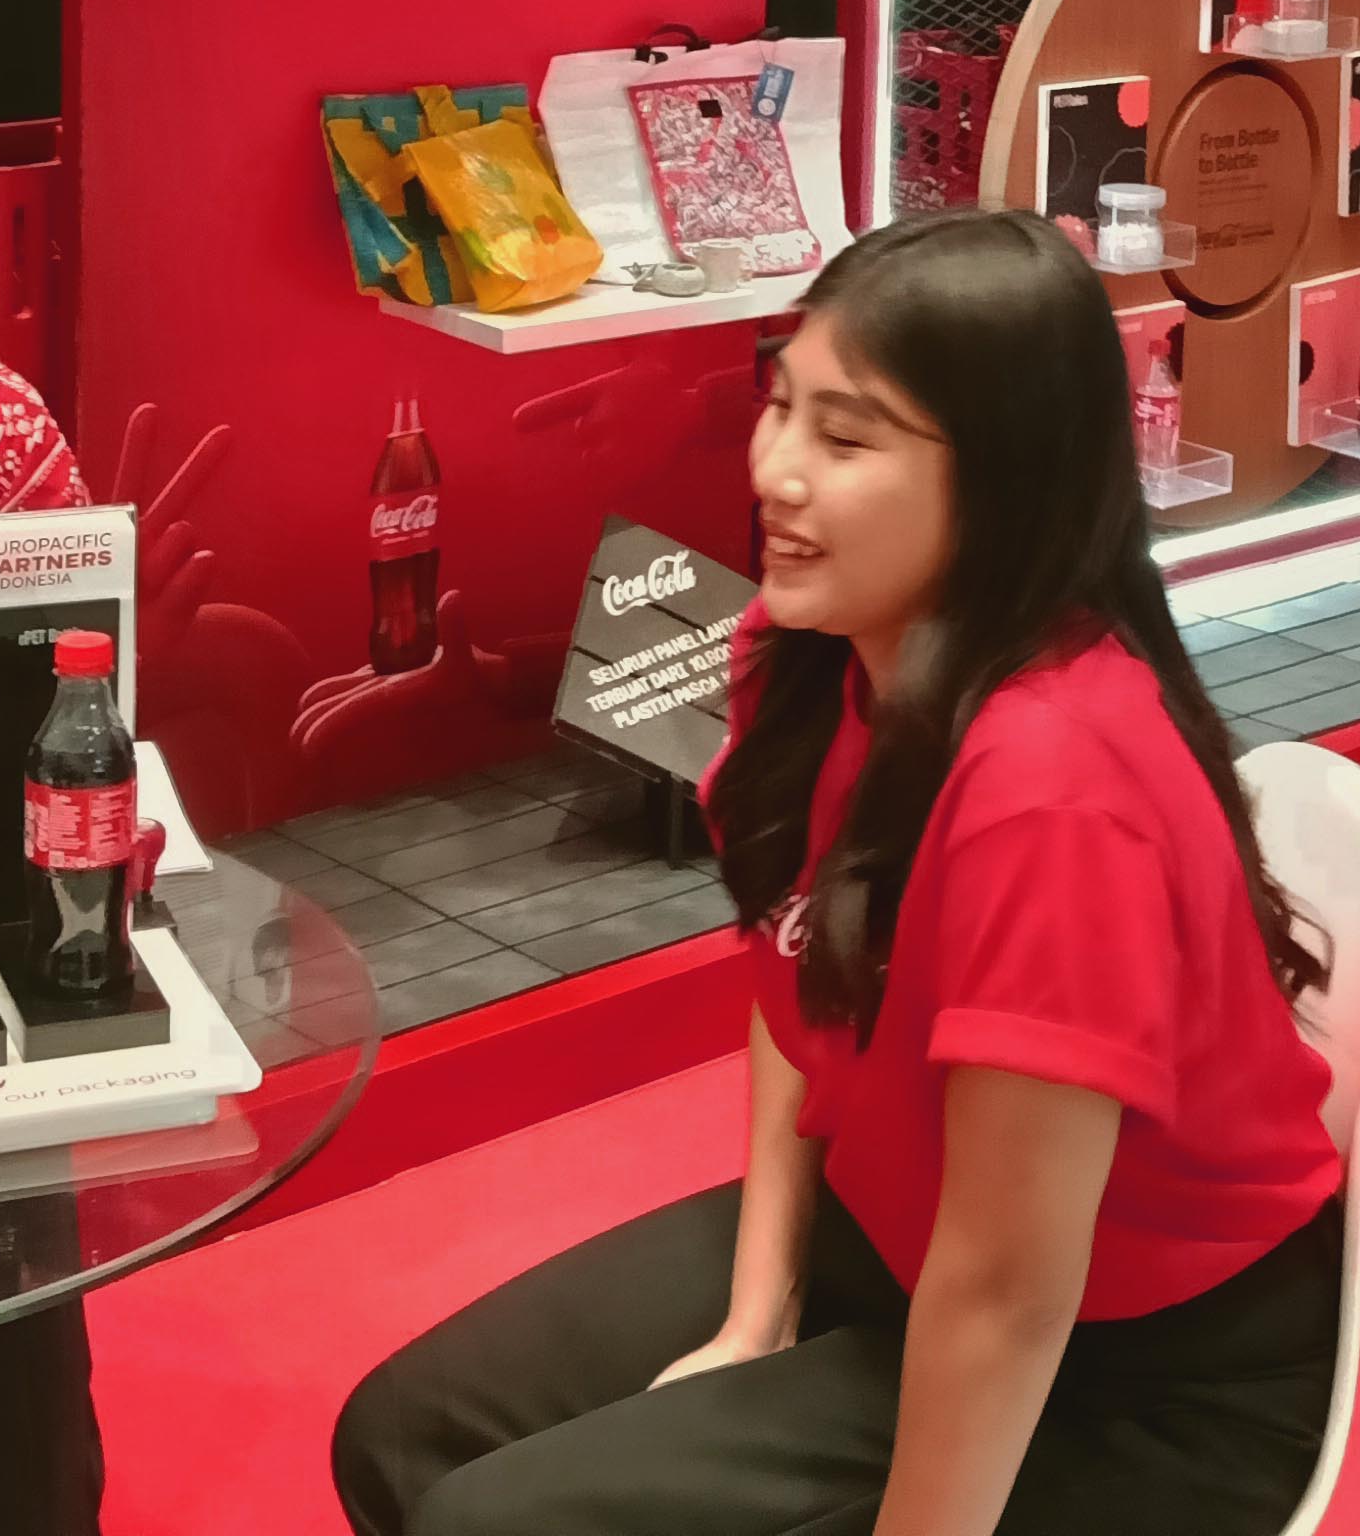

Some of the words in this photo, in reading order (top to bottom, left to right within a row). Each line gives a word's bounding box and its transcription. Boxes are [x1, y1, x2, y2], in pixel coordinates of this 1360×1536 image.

[588, 647, 658, 686] SELURUH
[653, 632, 701, 661] PANEL
[585, 676, 652, 713] TERBUAT
[648, 661, 690, 689] DARI
[611, 691, 678, 729] PLASTIK
[672, 675, 721, 705] PASCA
[5, 1089, 49, 1104] our
[57, 1067, 198, 1097] packaging
